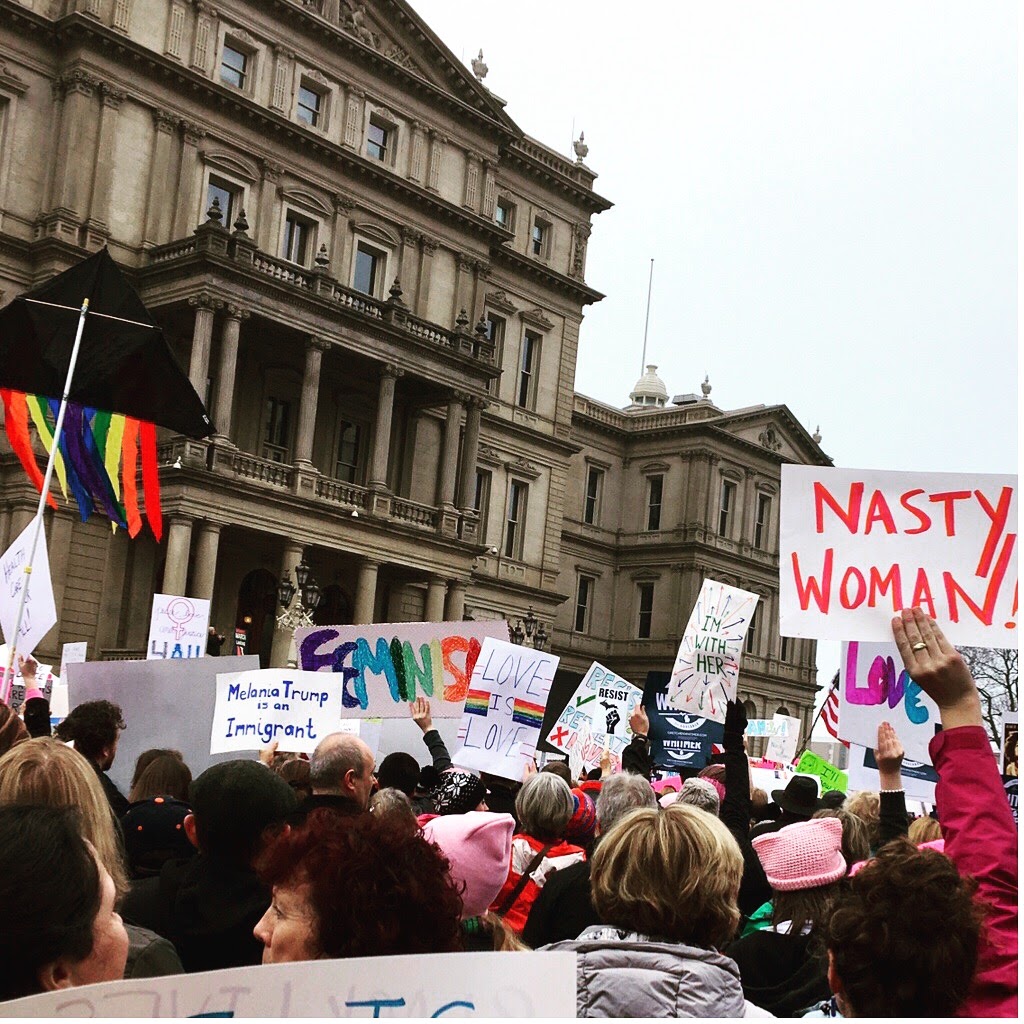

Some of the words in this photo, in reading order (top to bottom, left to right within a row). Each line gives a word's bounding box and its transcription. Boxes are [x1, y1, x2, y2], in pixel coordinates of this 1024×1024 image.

[813, 481, 1013, 578] NASTY
[791, 533, 1018, 630] WOMAN!
[695, 634, 727, 654] WITH
[482, 648, 551, 697] LOVE
[696, 653, 727, 678] HER
[227, 682, 279, 701] Melania
[282, 680, 329, 707] Trump
[273, 702, 289, 711] an
[490, 693, 514, 716] IS
[598, 687, 629, 701] RESIST
[225, 717, 317, 744] Immigrant
[465, 717, 528, 758] LOVE
